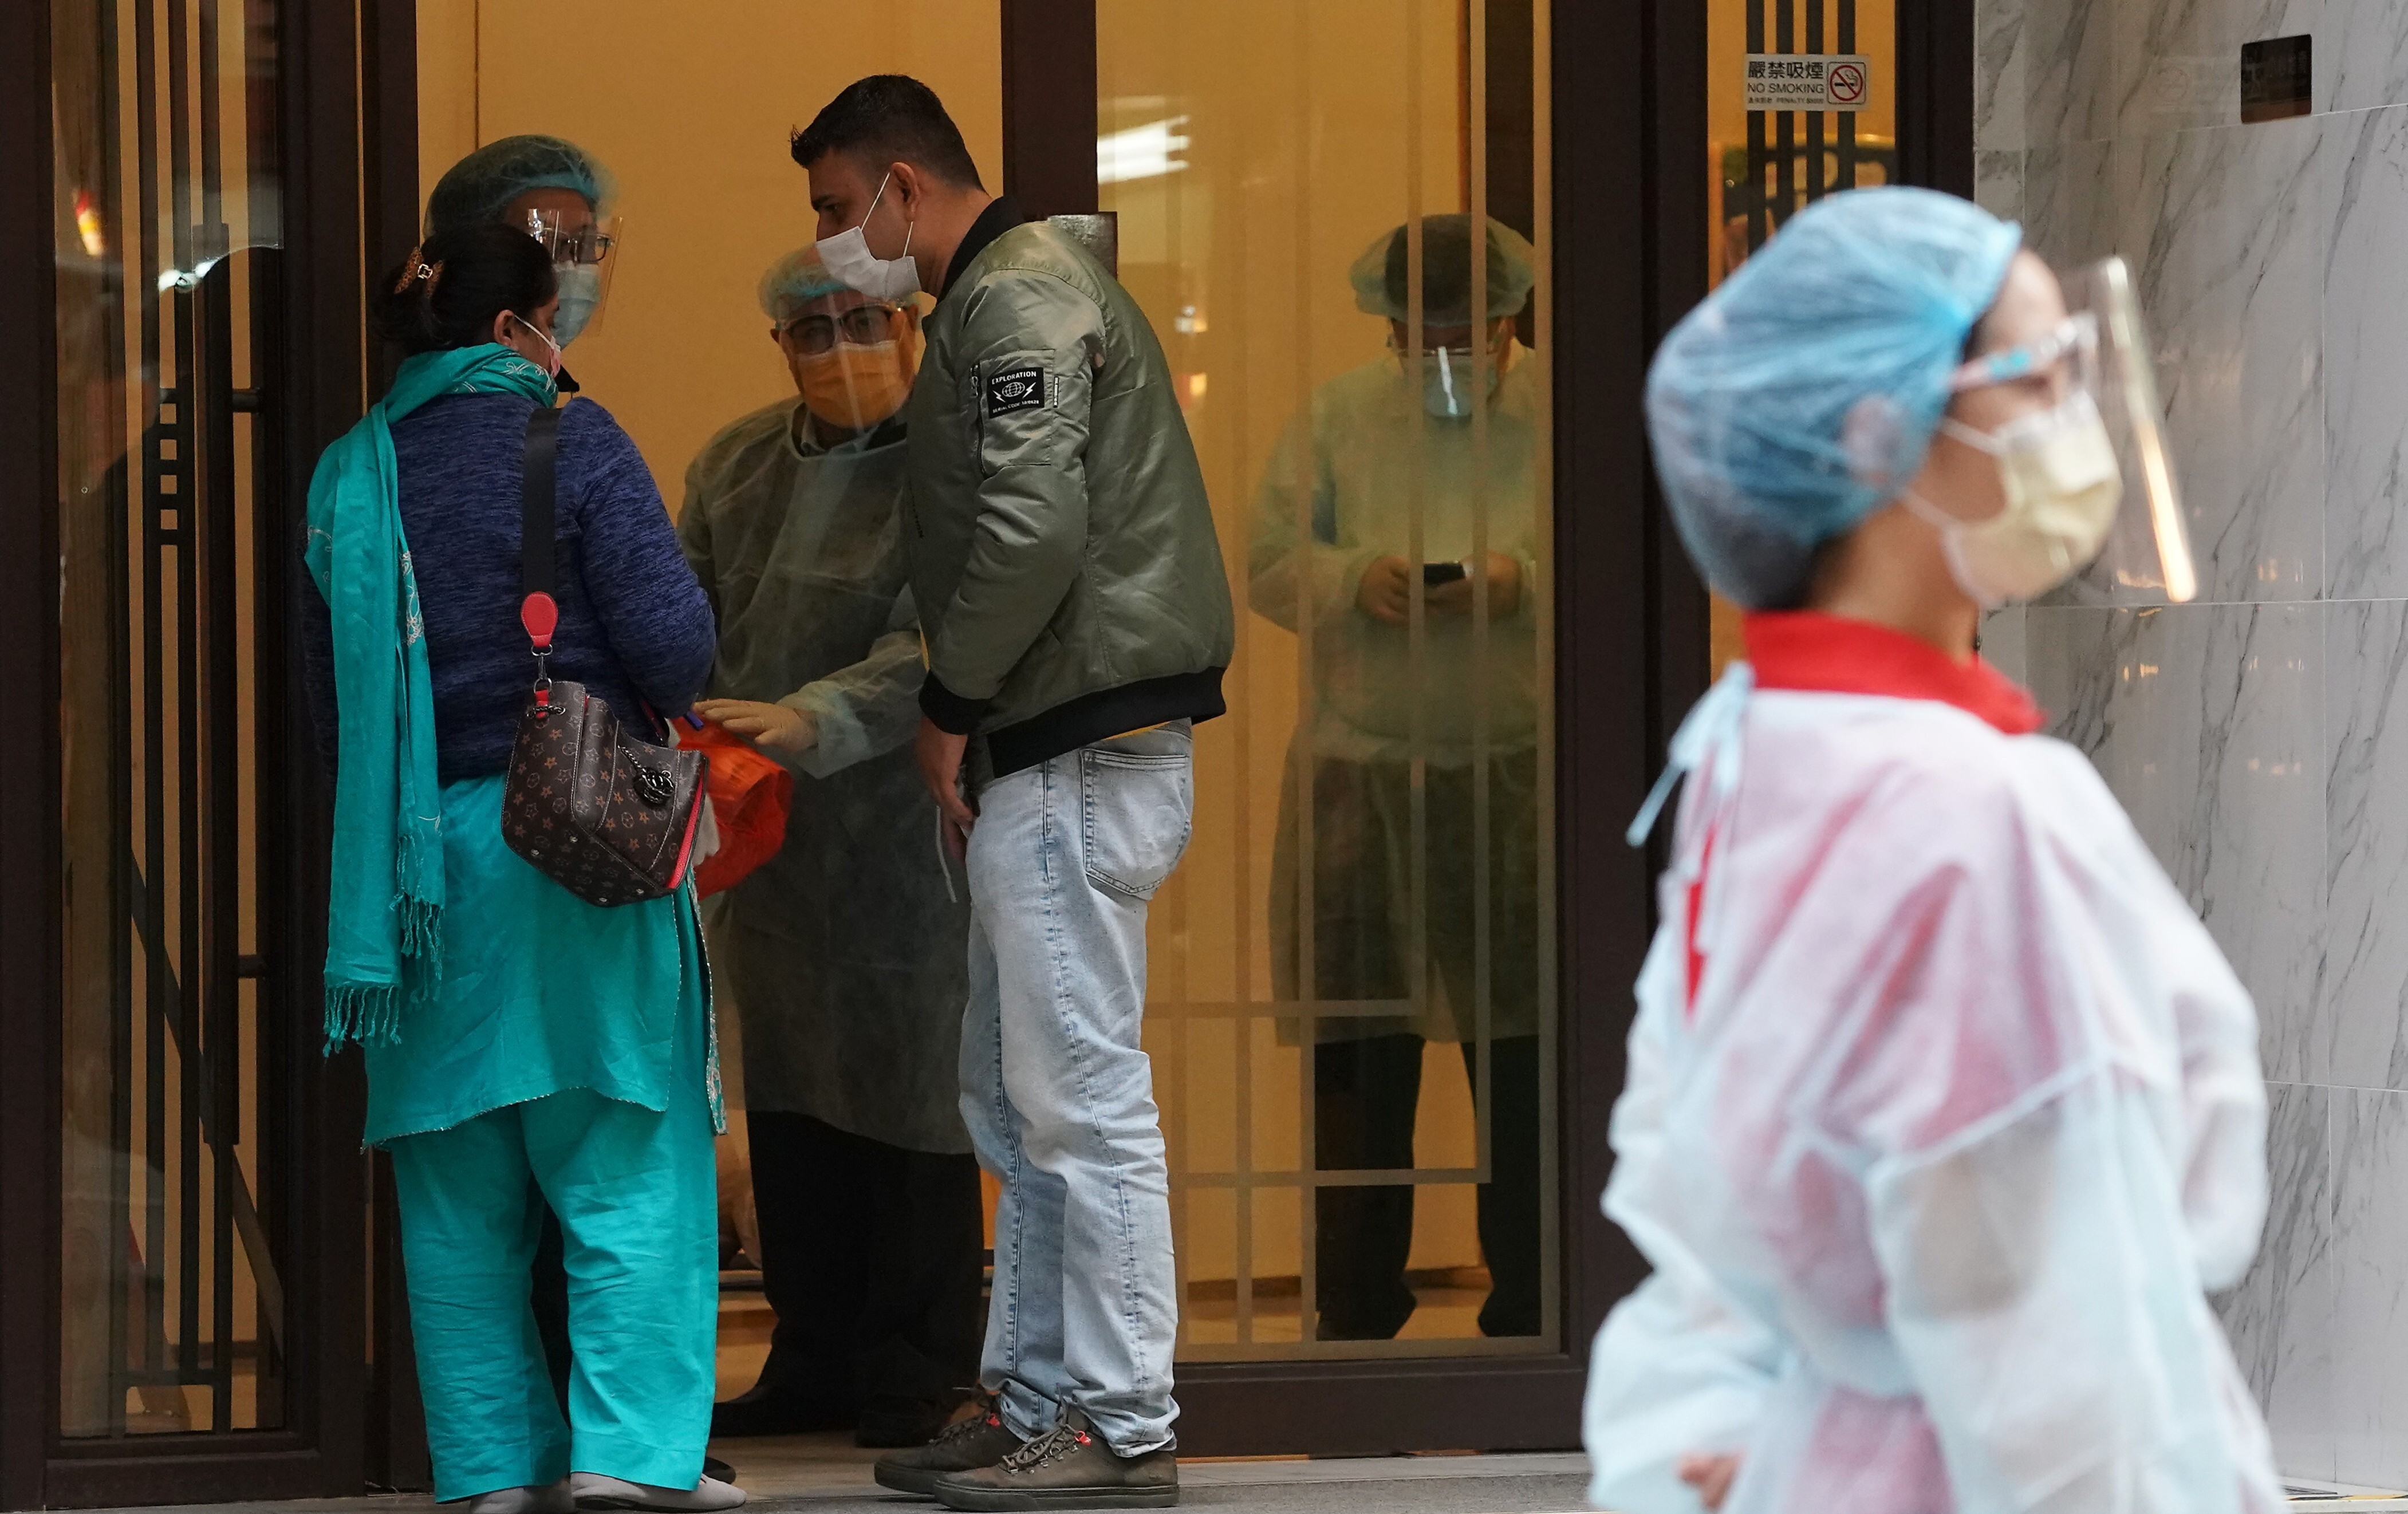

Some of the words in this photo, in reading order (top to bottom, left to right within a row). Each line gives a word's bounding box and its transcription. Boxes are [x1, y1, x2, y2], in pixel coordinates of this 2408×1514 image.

[1748, 61, 1823, 79] 嚴禁吸煙
[1748, 83, 1765, 93] NO
[1769, 83, 1824, 93] SMOKING
[992, 371, 1036, 385] EXPLORATION
